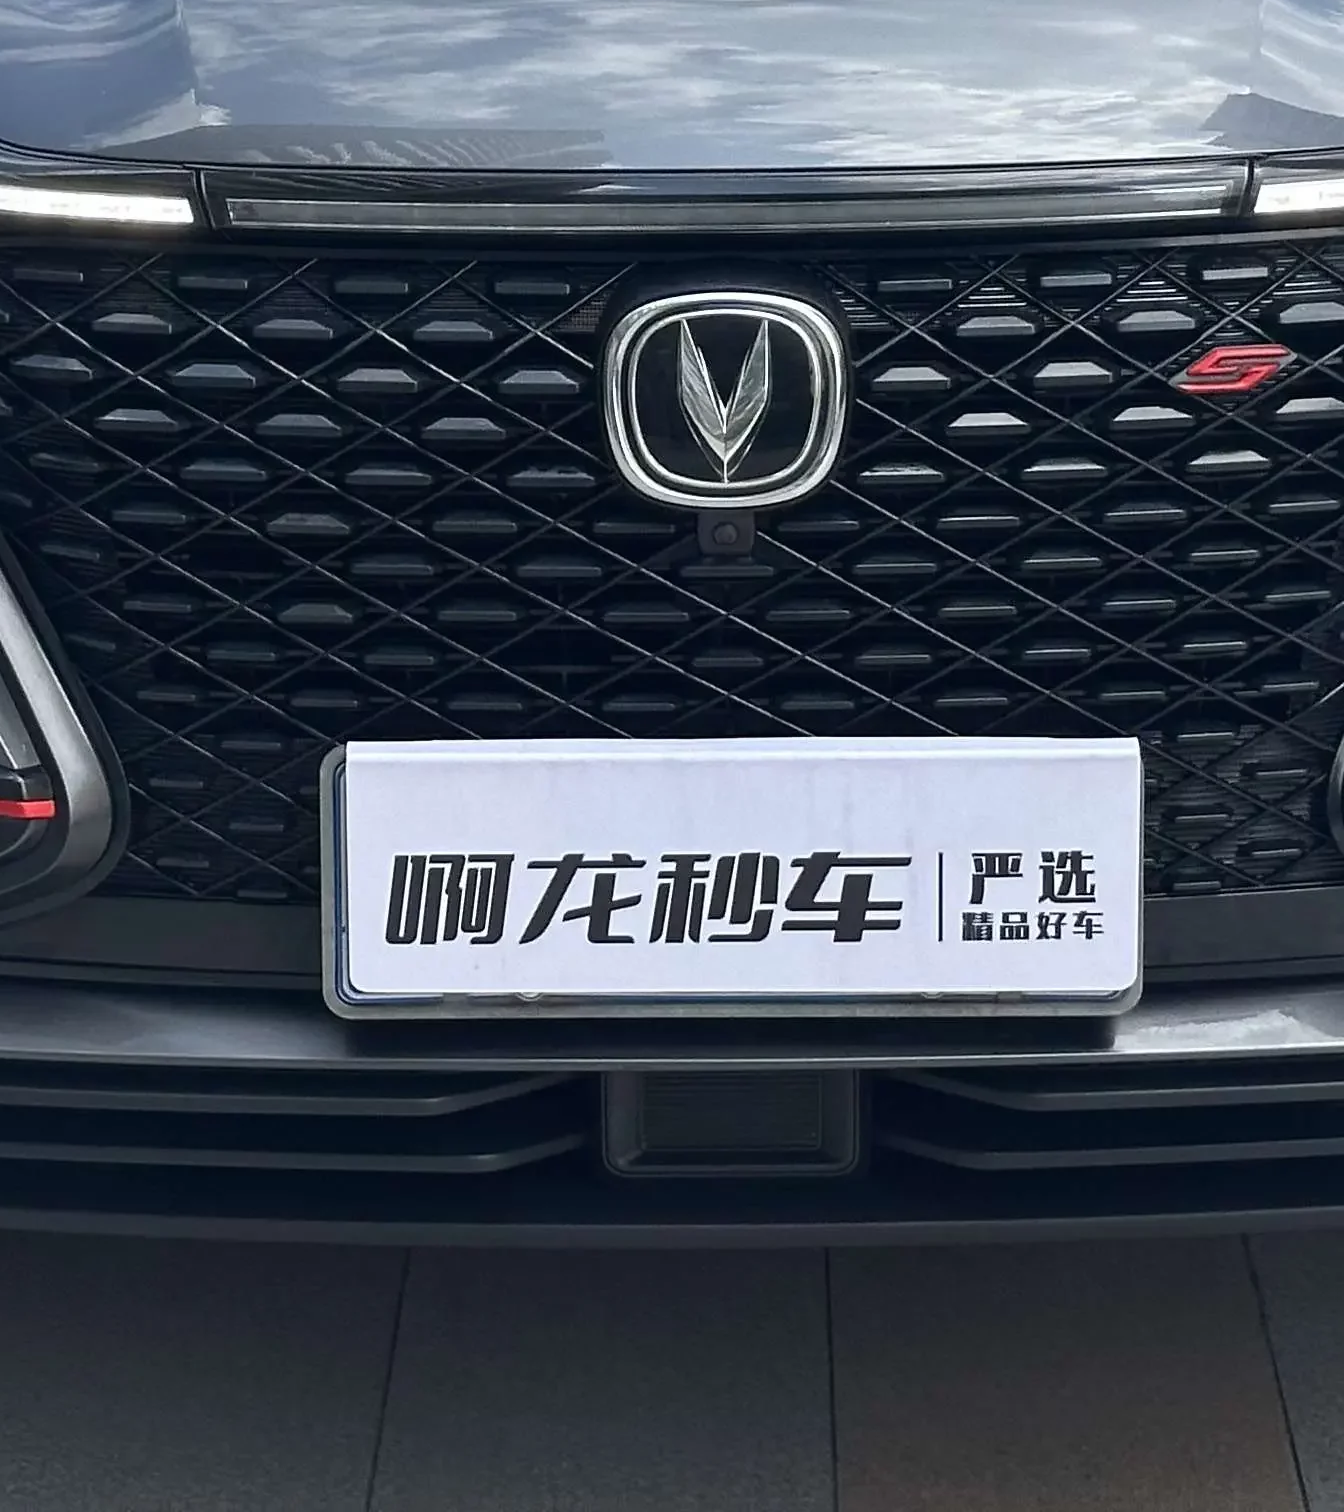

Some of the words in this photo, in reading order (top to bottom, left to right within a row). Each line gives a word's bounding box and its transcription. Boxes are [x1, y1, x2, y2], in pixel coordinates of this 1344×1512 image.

[385, 851, 913, 945] 啊龙秒车
[969, 850, 1097, 905] 严选
[961, 910, 1105, 942] 精品好车
